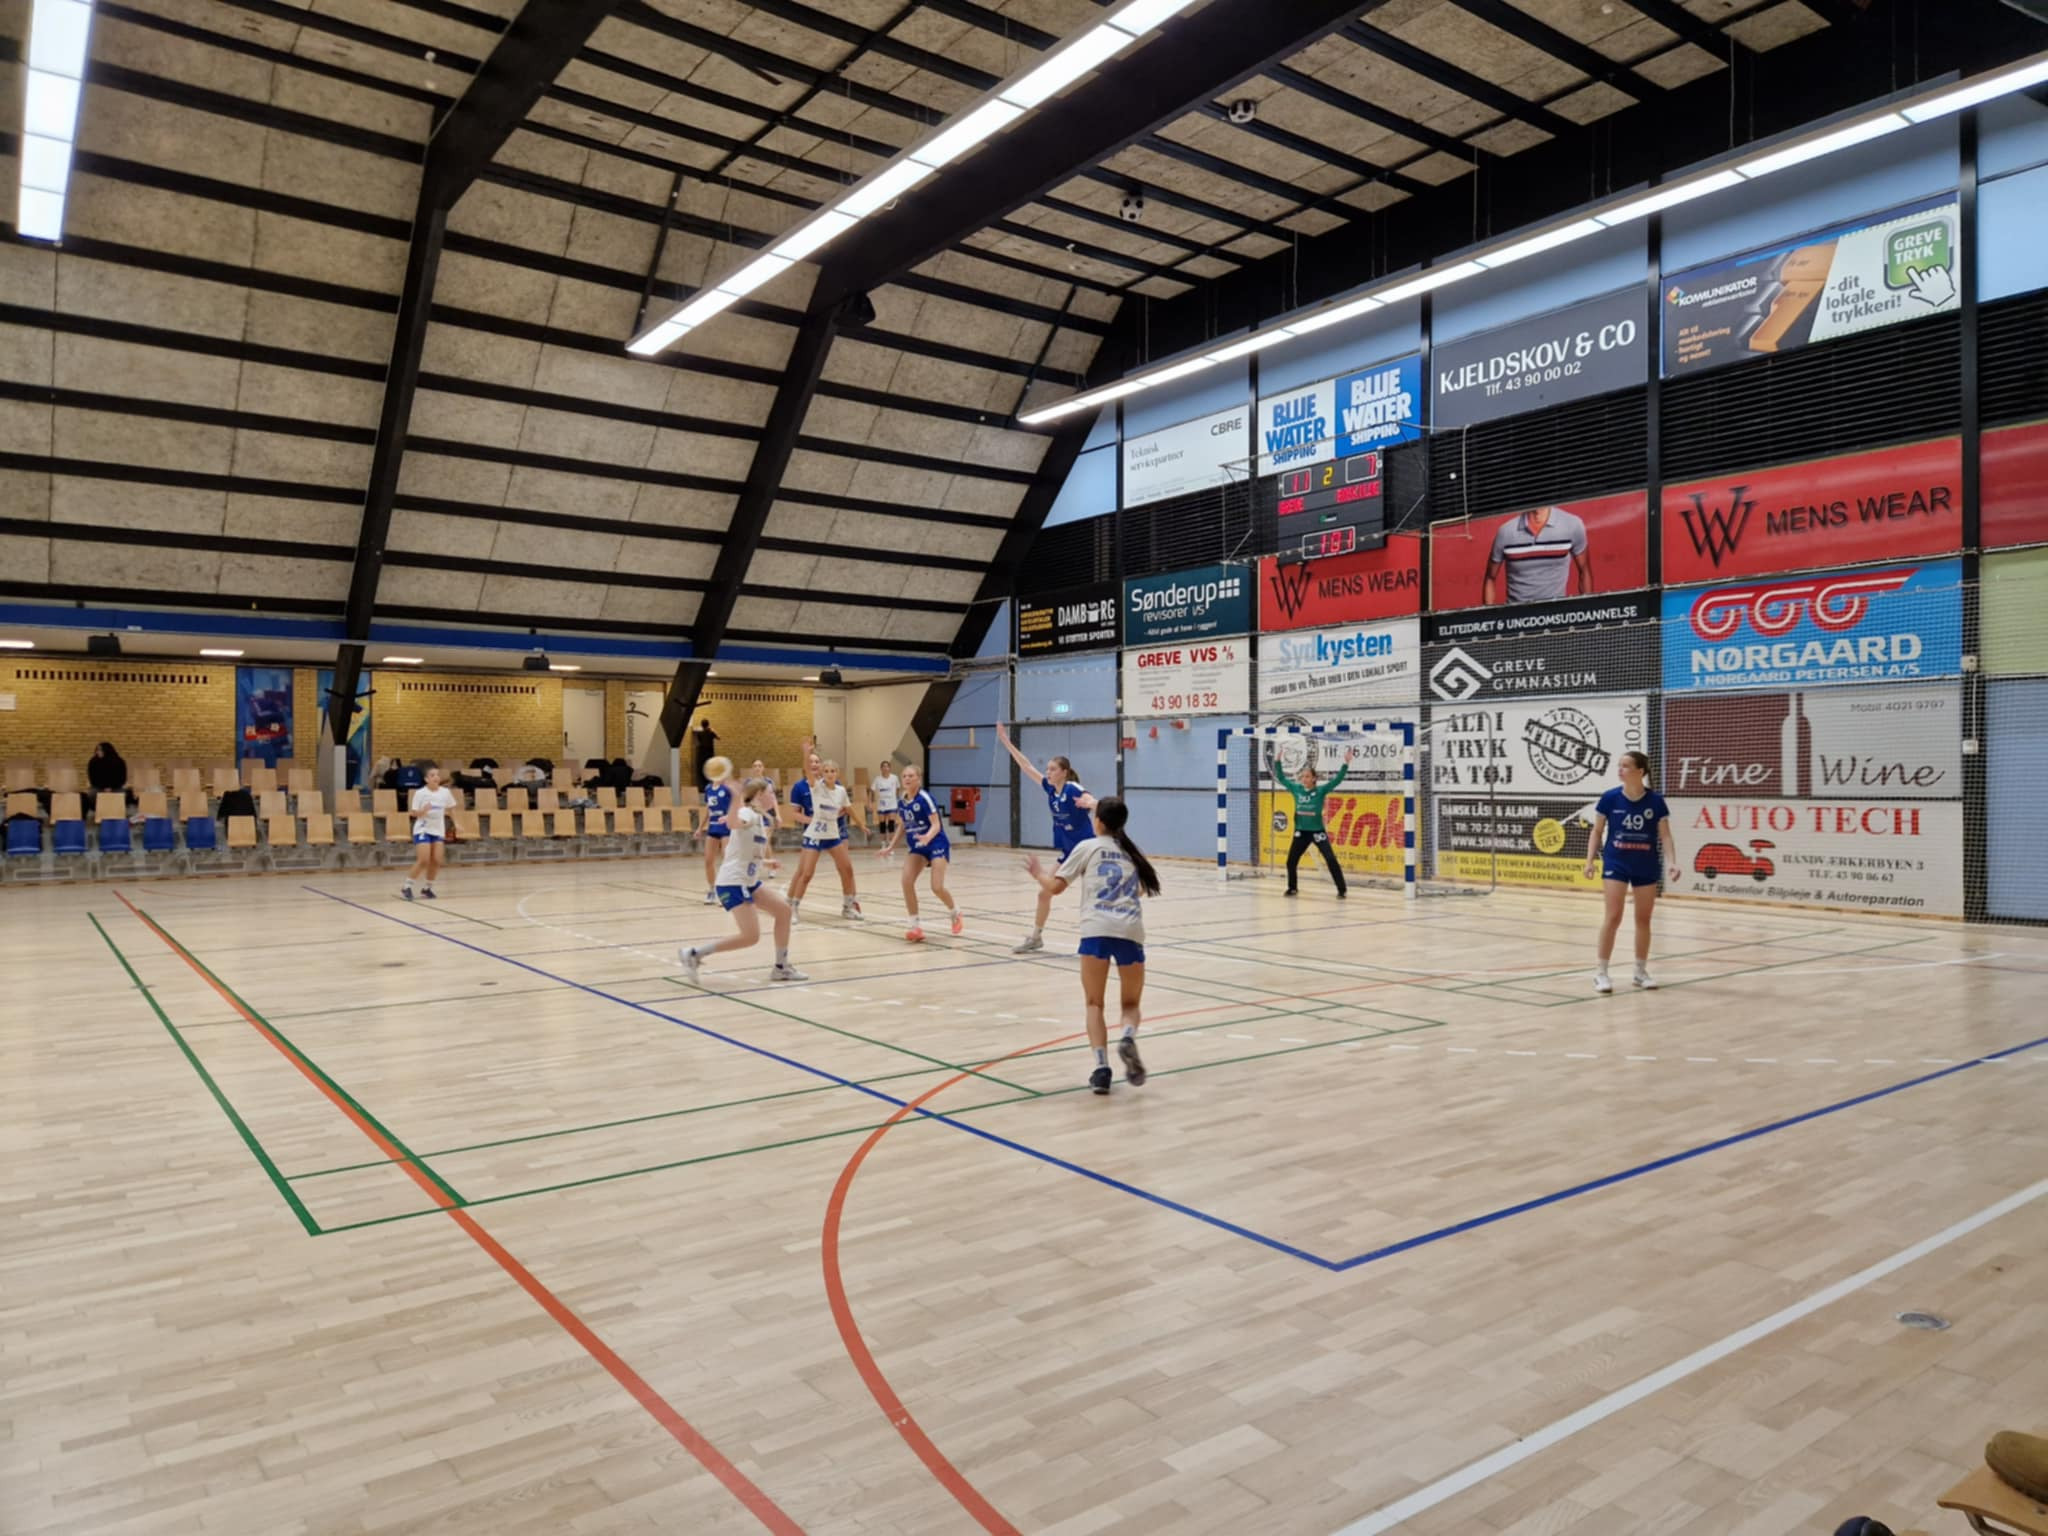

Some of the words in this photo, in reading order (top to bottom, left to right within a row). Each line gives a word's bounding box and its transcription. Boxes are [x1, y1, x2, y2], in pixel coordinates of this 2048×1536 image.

[1894, 227, 1942, 251] GREVE
[1895, 243, 1933, 265] TRYK
[1838, 275, 1860, 292] dit
[1826, 288, 1875, 310] lokale
[1832, 295, 1902, 323] trykkeri!
[1439, 338, 1571, 394] KJELDSKOV
[1575, 332, 1594, 357] &
[1600, 319, 1636, 351] CO
[1351, 368, 1401, 405] BLUE
[1485, 383, 1503, 397] Tlf.
[1505, 376, 1521, 391] 43
[1524, 372, 1541, 387] 90
[1544, 367, 1561, 382] 00
[1564, 361, 1582, 377] 02
[1272, 394, 1316, 427] BLUE
[1342, 392, 1412, 432] WATER
[1210, 417, 1242, 436] CBRE
[1265, 416, 1326, 453] WATER
[1351, 423, 1400, 446] SHIPPING
[1273, 444, 1316, 465] SHIPPING
[1292, 471, 1310, 494] 11
[1322, 466, 1334, 486] 2
[1365, 455, 1377, 477] 7
[1766, 502, 1848, 535] MENS
[1857, 486, 1952, 523] WEAR
[1318, 575, 1363, 598] MENS
[1368, 569, 1418, 592] WEAR
[1131, 582, 1217, 612] Sønderup
[1143, 606, 1188, 622] revisorer
[1438, 620, 1496, 636] ELITEIDRÆT
[1497, 619, 1504, 630] &
[1506, 606, 1638, 630] UNGDOMSUDDANNELSE
[1138, 651, 1182, 668] GREVE
[1190, 647, 1217, 663] VVS
[1279, 632, 1393, 667] Sydkysten
[1691, 633, 1922, 673] NØRGAARD
[1361, 665, 1385, 678] LOKALE
[1386, 661, 1408, 673] SPORT
[1492, 658, 1546, 673] GREVE
[1795, 664, 1883, 681] PETERSEN
[1888, 663, 1921, 675] A/S
[1492, 672, 1597, 690] GYMNASIUM
[1151, 696, 1165, 710] 43
[1168, 695, 1182, 709] 90
[1186, 694, 1200, 708] 18
[1202, 693, 1218, 707] 32
[1445, 712, 1487, 733] ALT
[1495, 711, 1504, 732] I
[1552, 711, 1593, 738] TEXTIL
[1362, 745, 1375, 757] 20
[1441, 738, 1507, 758] TRYK
[1527, 724, 1578, 760] TRYK
[1582, 749, 1607, 771] 10
[1434, 759, 1461, 784] PÅ
[1467, 764, 1513, 785] TØJ
[1677, 756, 1773, 789] Fine
[1819, 754, 1946, 787] Wine
[1441, 804, 1470, 816] DANSK
[1505, 805, 1538, 817] ALARM
[1622, 813, 1644, 830] 49
[1692, 804, 1796, 831] AUTO
[1807, 806, 1922, 836] TECH
[814, 821, 827, 832] 24
[1483, 823, 1493, 833] 2
[1510, 824, 1523, 835] 33
[747, 862, 756, 877] 6
[1692, 882, 1714, 892] ALT
[1718, 883, 1764, 896] indenfor
[1767, 886, 1811, 900] Bilpleje
[1814, 889, 1823, 899] &
[1828, 891, 1924, 907] Autoreparation
